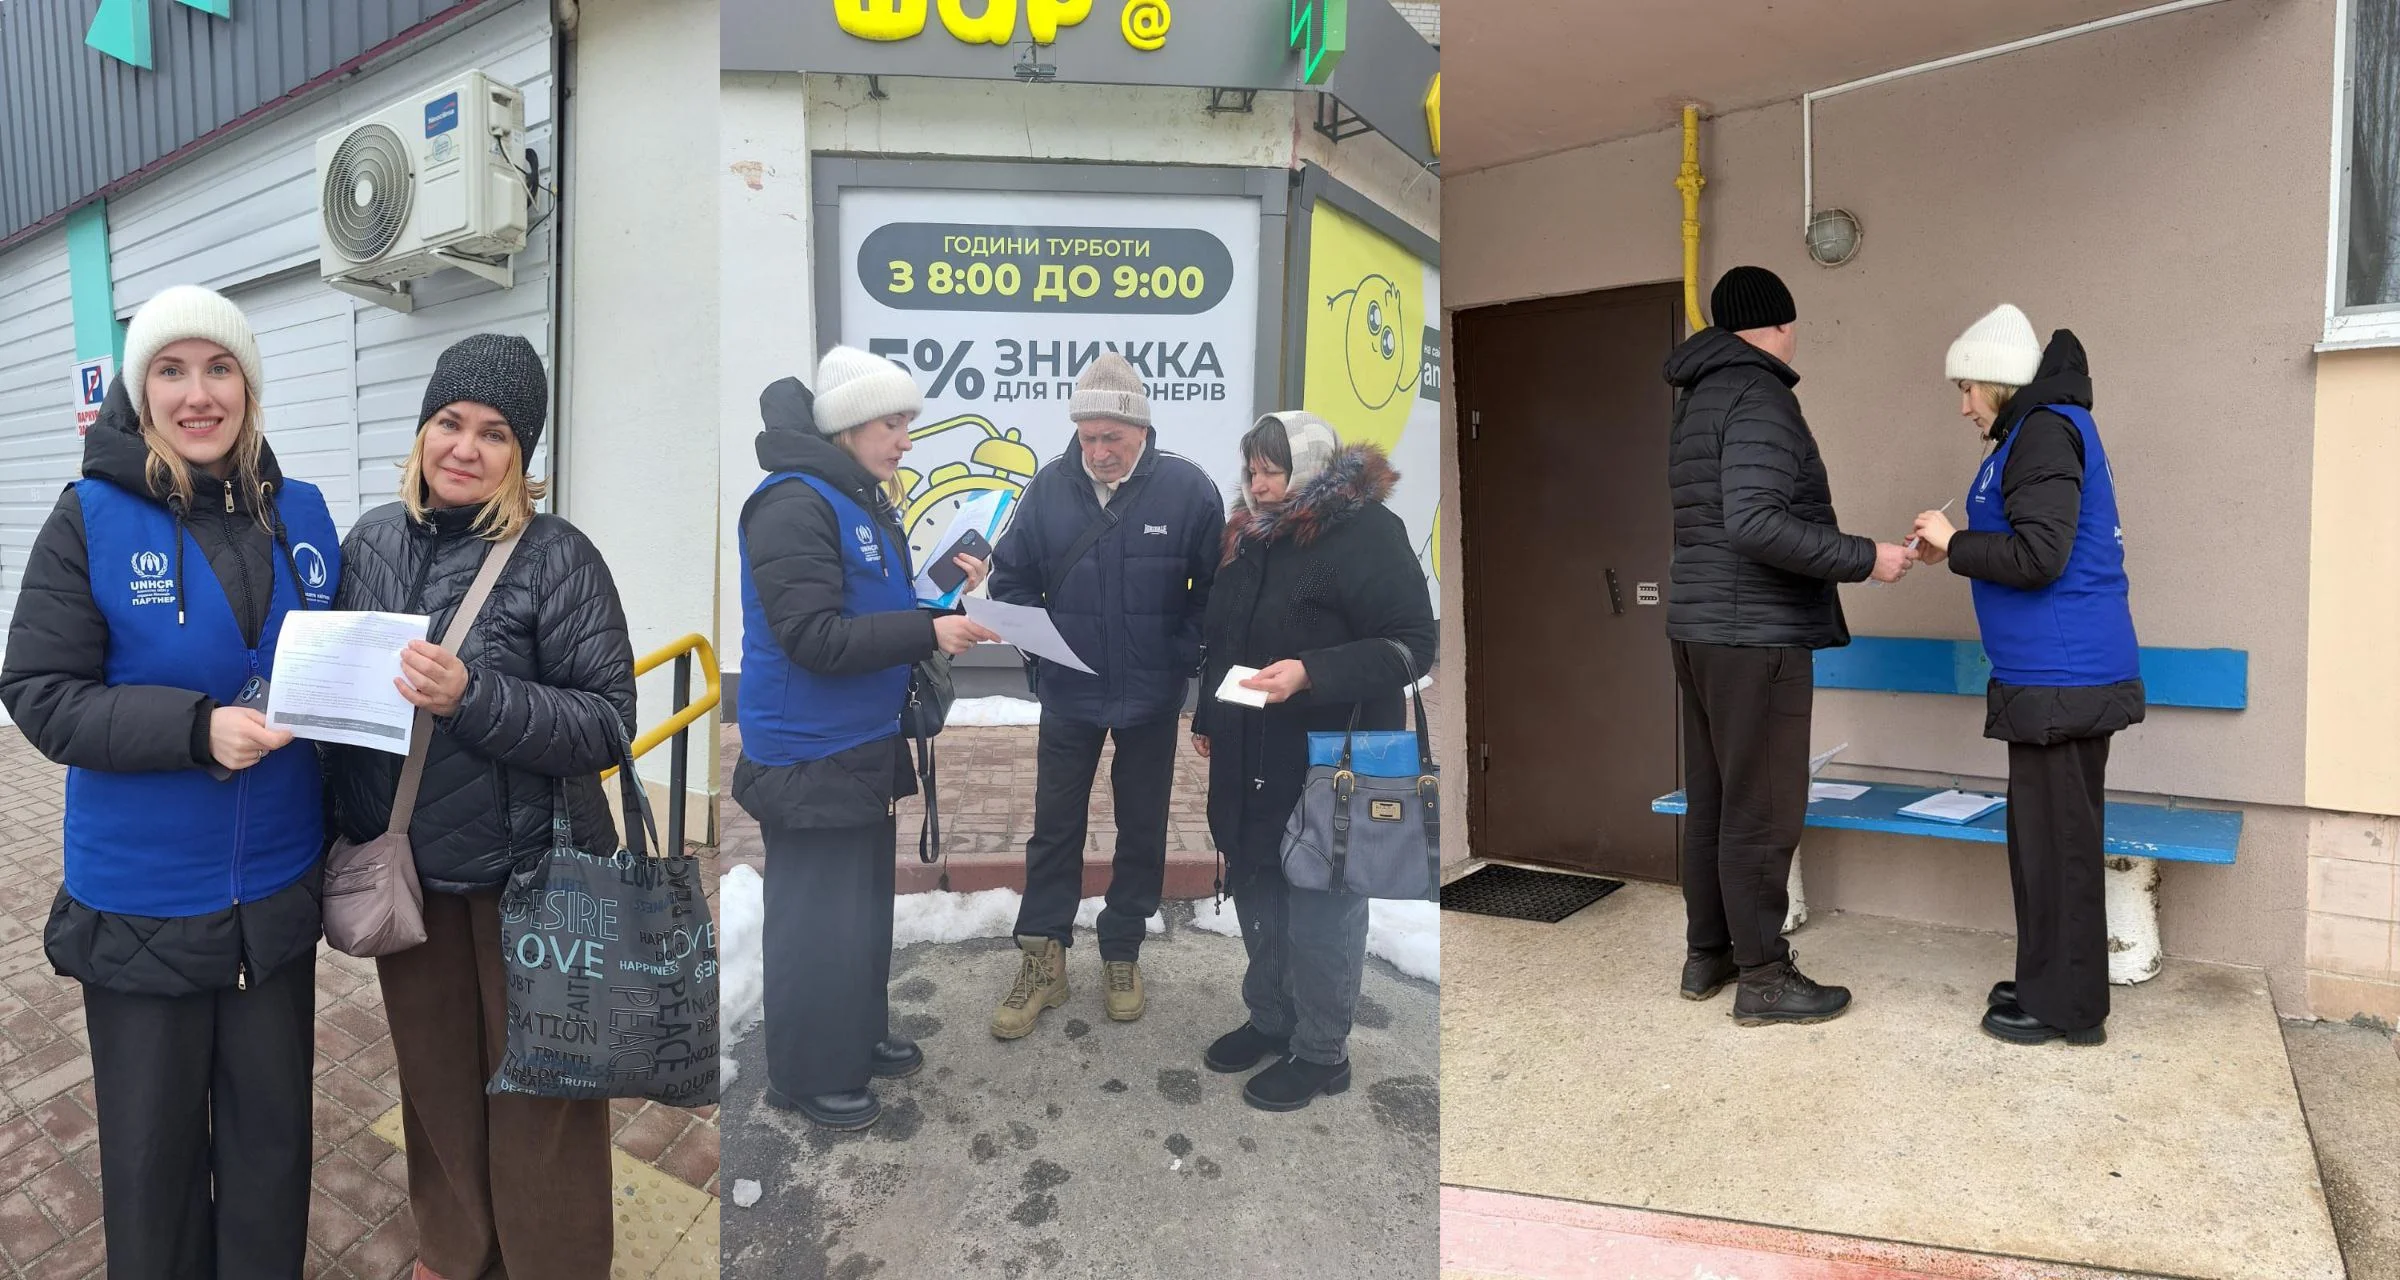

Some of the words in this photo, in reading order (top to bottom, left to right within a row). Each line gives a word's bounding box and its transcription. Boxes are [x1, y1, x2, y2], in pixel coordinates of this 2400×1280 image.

[944, 236, 1039, 256] ГОДИНИ
[1047, 238, 1150, 257] ТУРБОТИ
[927, 263, 1021, 295] 8:00
[1033, 265, 1101, 302] ДО
[1113, 265, 1204, 299] 9:00
[994, 382, 1047, 402] ДЛЯ
[130, 580, 174, 590] UNHCR
[132, 596, 176, 605] ПАРТНЕР
[504, 889, 619, 941] DESIRE
[559, 1075, 597, 1088] TRUTH
